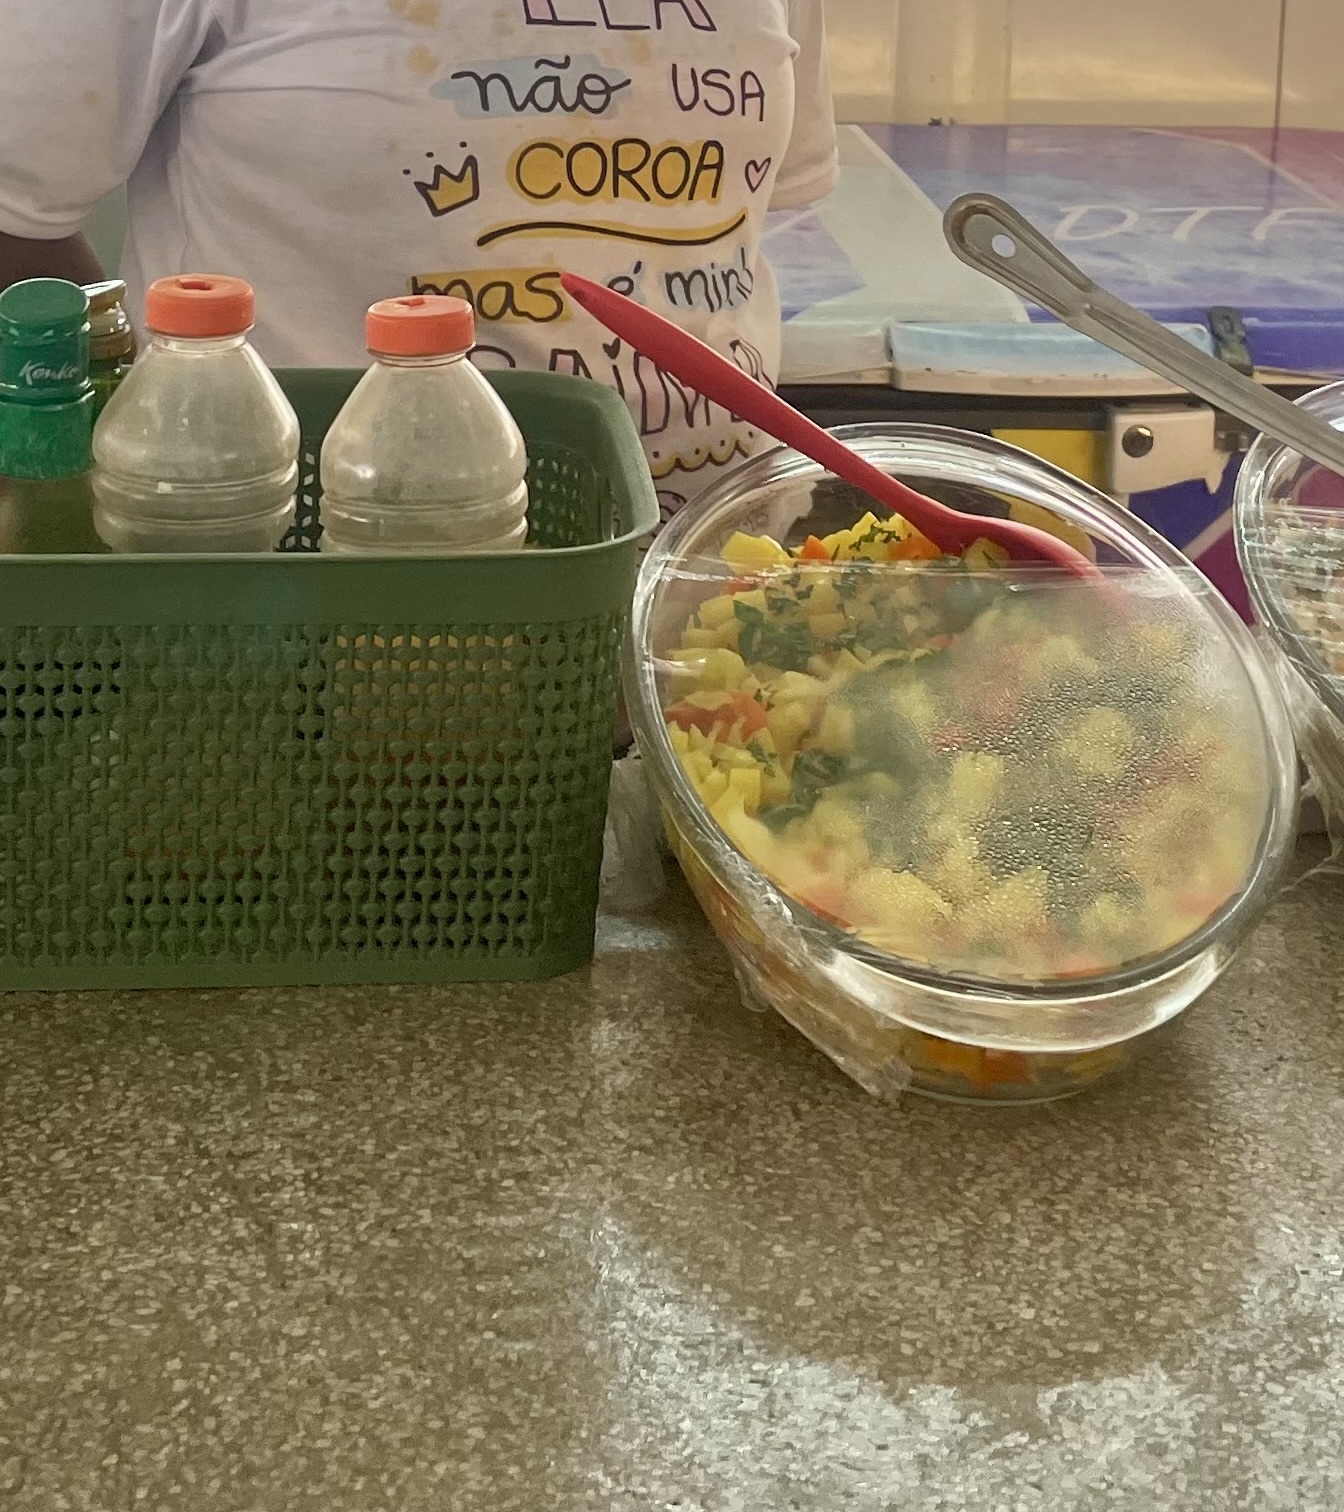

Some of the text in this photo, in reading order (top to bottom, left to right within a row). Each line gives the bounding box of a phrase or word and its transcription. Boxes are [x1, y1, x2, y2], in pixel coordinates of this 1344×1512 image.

[451, 55, 765, 122] não USA
[515, 139, 725, 201] COROA
